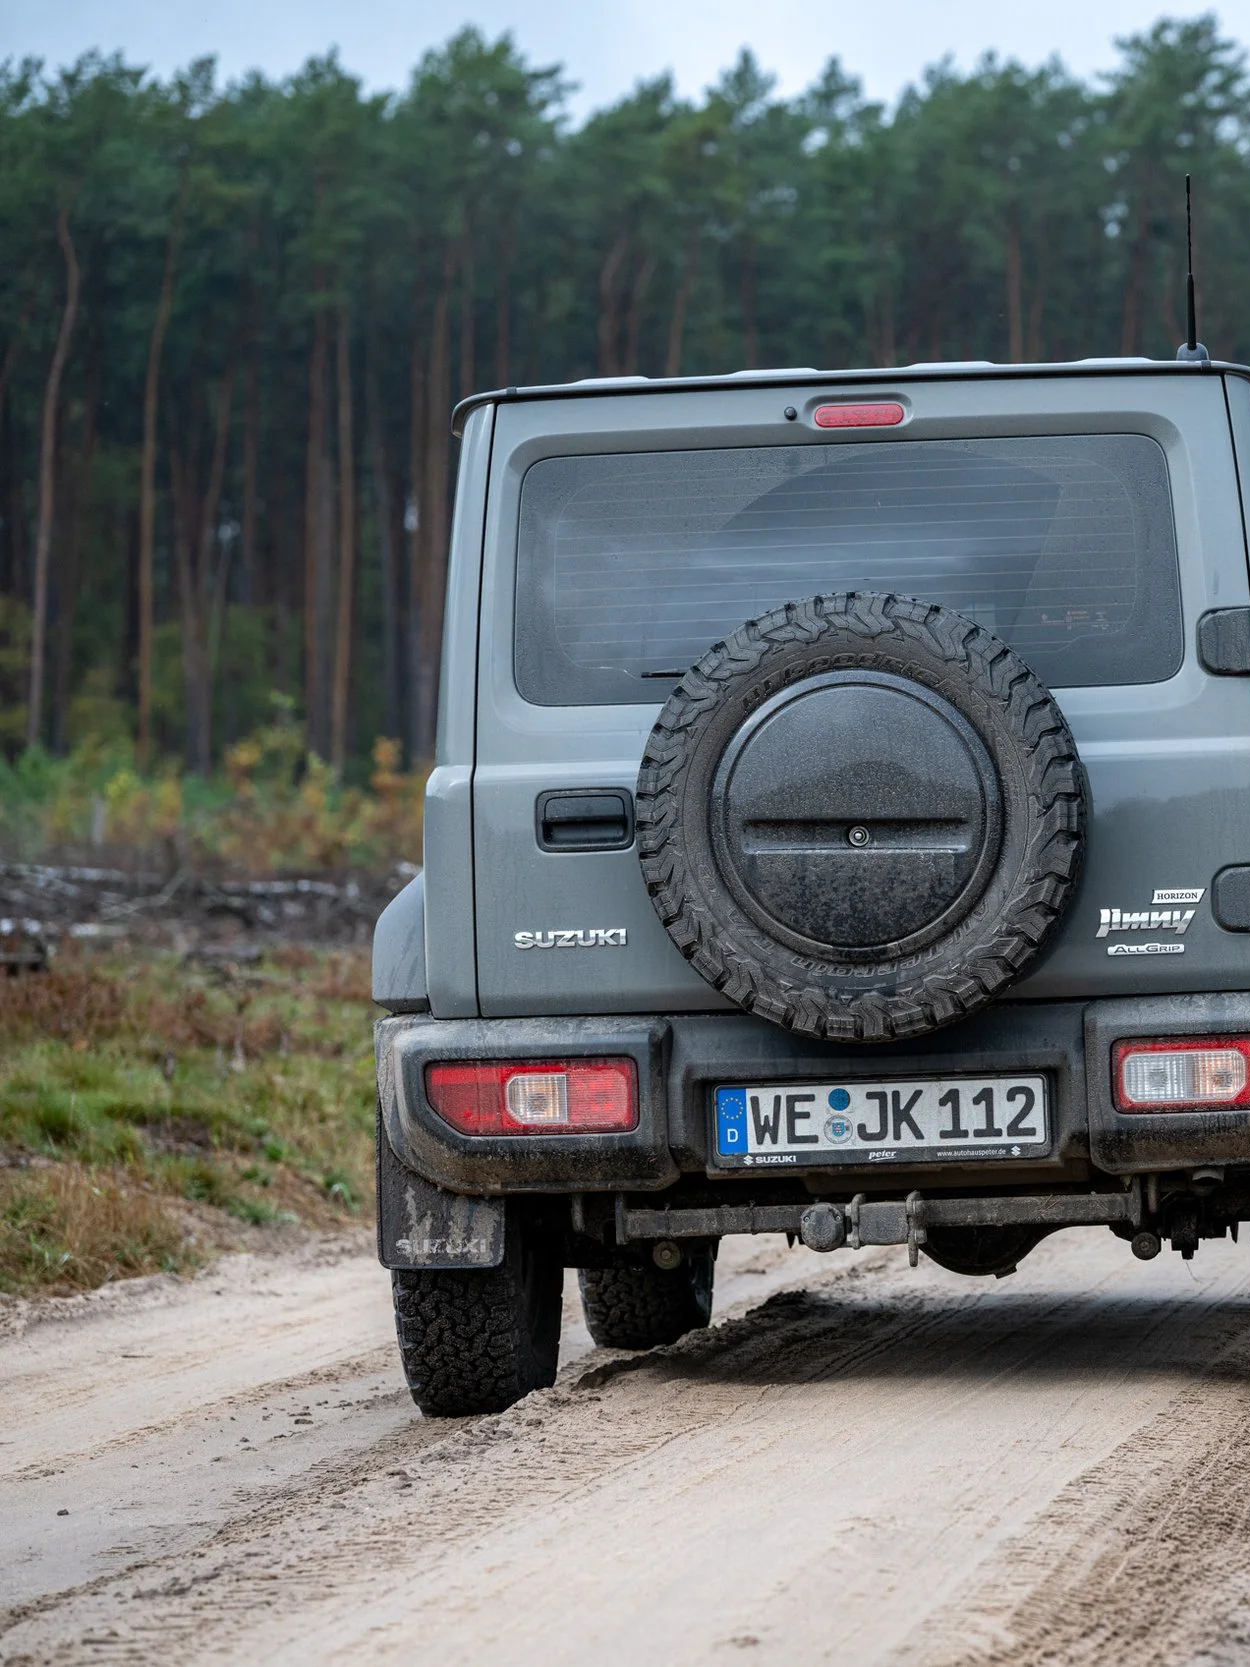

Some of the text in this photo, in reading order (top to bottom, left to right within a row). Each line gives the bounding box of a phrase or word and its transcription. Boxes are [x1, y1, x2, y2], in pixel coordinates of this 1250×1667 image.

[1156, 891, 1198, 900] HORIZON
[1095, 908, 1196, 938] Jimny
[514, 928, 627, 950] SUZUKI
[749, 1093, 820, 1146] WE
[856, 1089, 925, 1142] JK
[938, 1085, 1037, 1139] 112
[727, 1129, 739, 1143] D
[755, 1155, 797, 1164] SUZUKI
[936, 1147, 1007, 1158] www.autohauspeter.de
